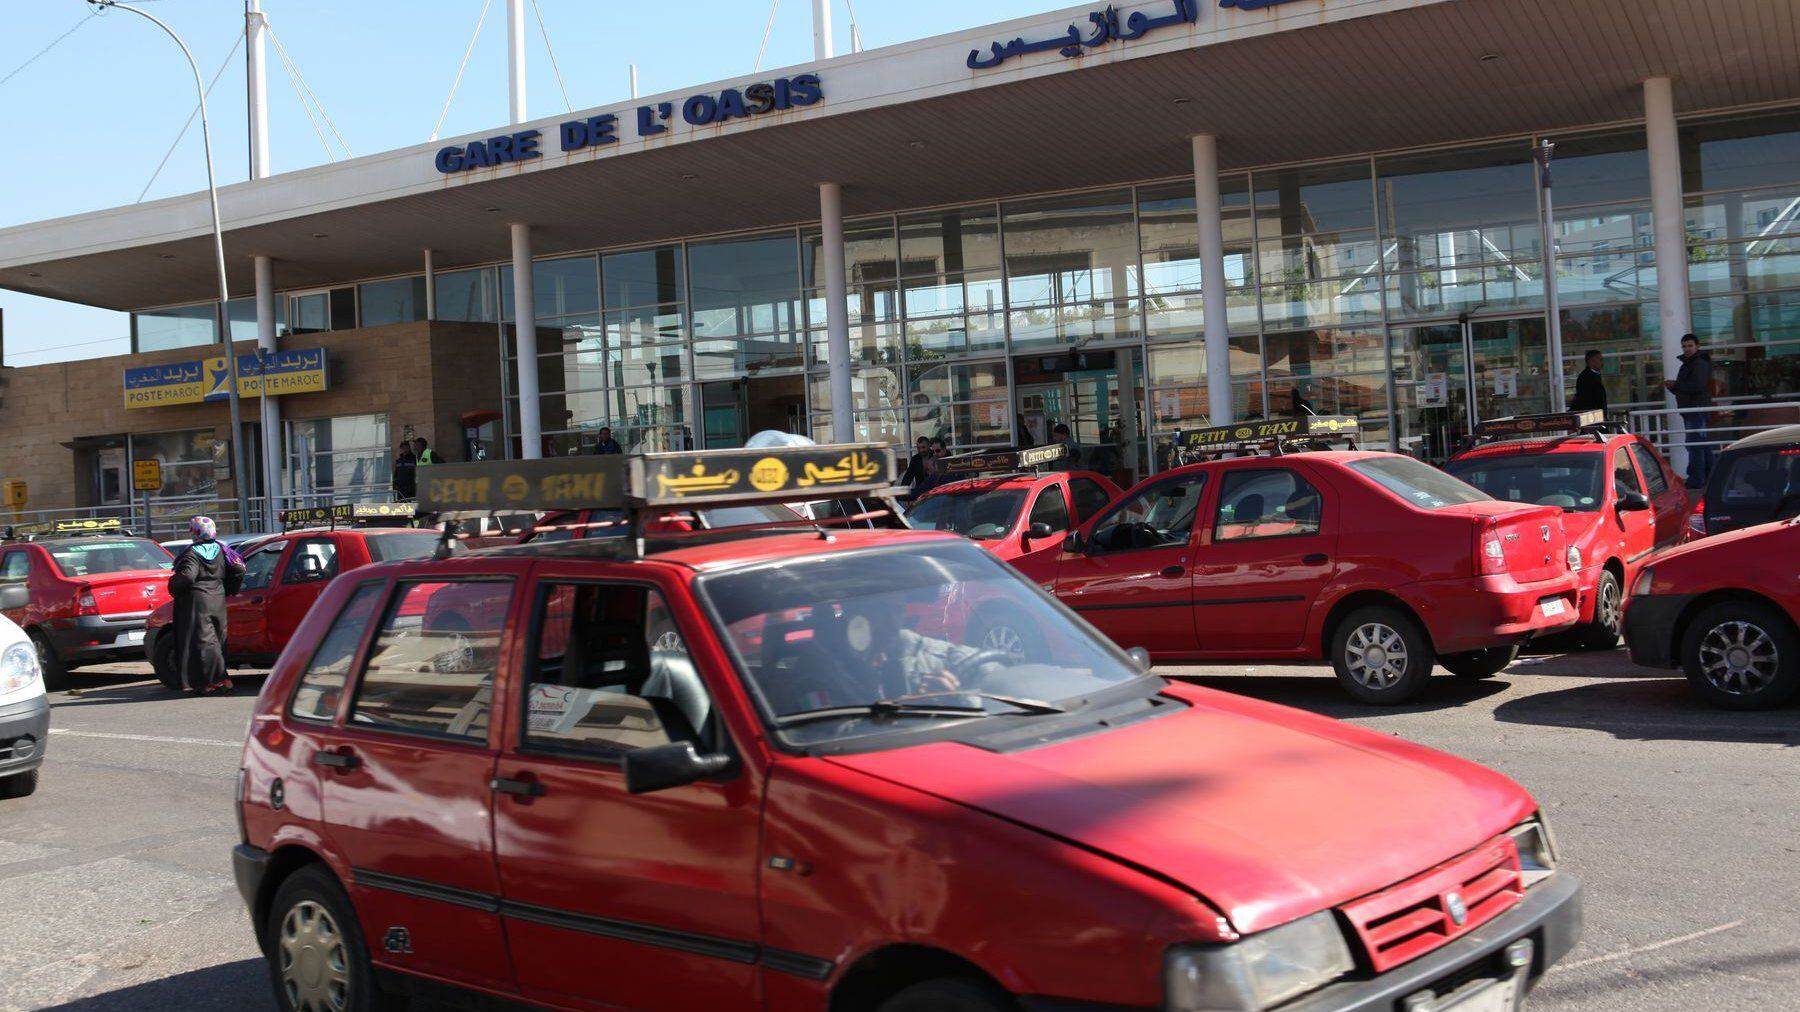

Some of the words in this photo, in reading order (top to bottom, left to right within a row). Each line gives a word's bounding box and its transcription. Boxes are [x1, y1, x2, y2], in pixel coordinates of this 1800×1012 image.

[435, 129, 543, 174] GARE
[560, 113, 619, 152] DE
[637, 102, 671, 136] L'
[683, 73, 826, 125] OASIS
[242, 355, 278, 376] المرب
[280, 352, 319, 370] بريد
[163, 366, 199, 383] بريد
[281, 374, 320, 387] MAROC
[129, 389, 163, 403] POSTE
[163, 385, 201, 400] MAROC
[1189, 430, 1229, 444] PETIT
[1257, 421, 1301, 436] TAXI
[1028, 450, 1045, 463] PETIT
[656, 458, 741, 498] صغير
[796, 451, 880, 487] طاكسي
[287, 510, 312, 521] PETIT
[331, 505, 351, 517] TAXI
